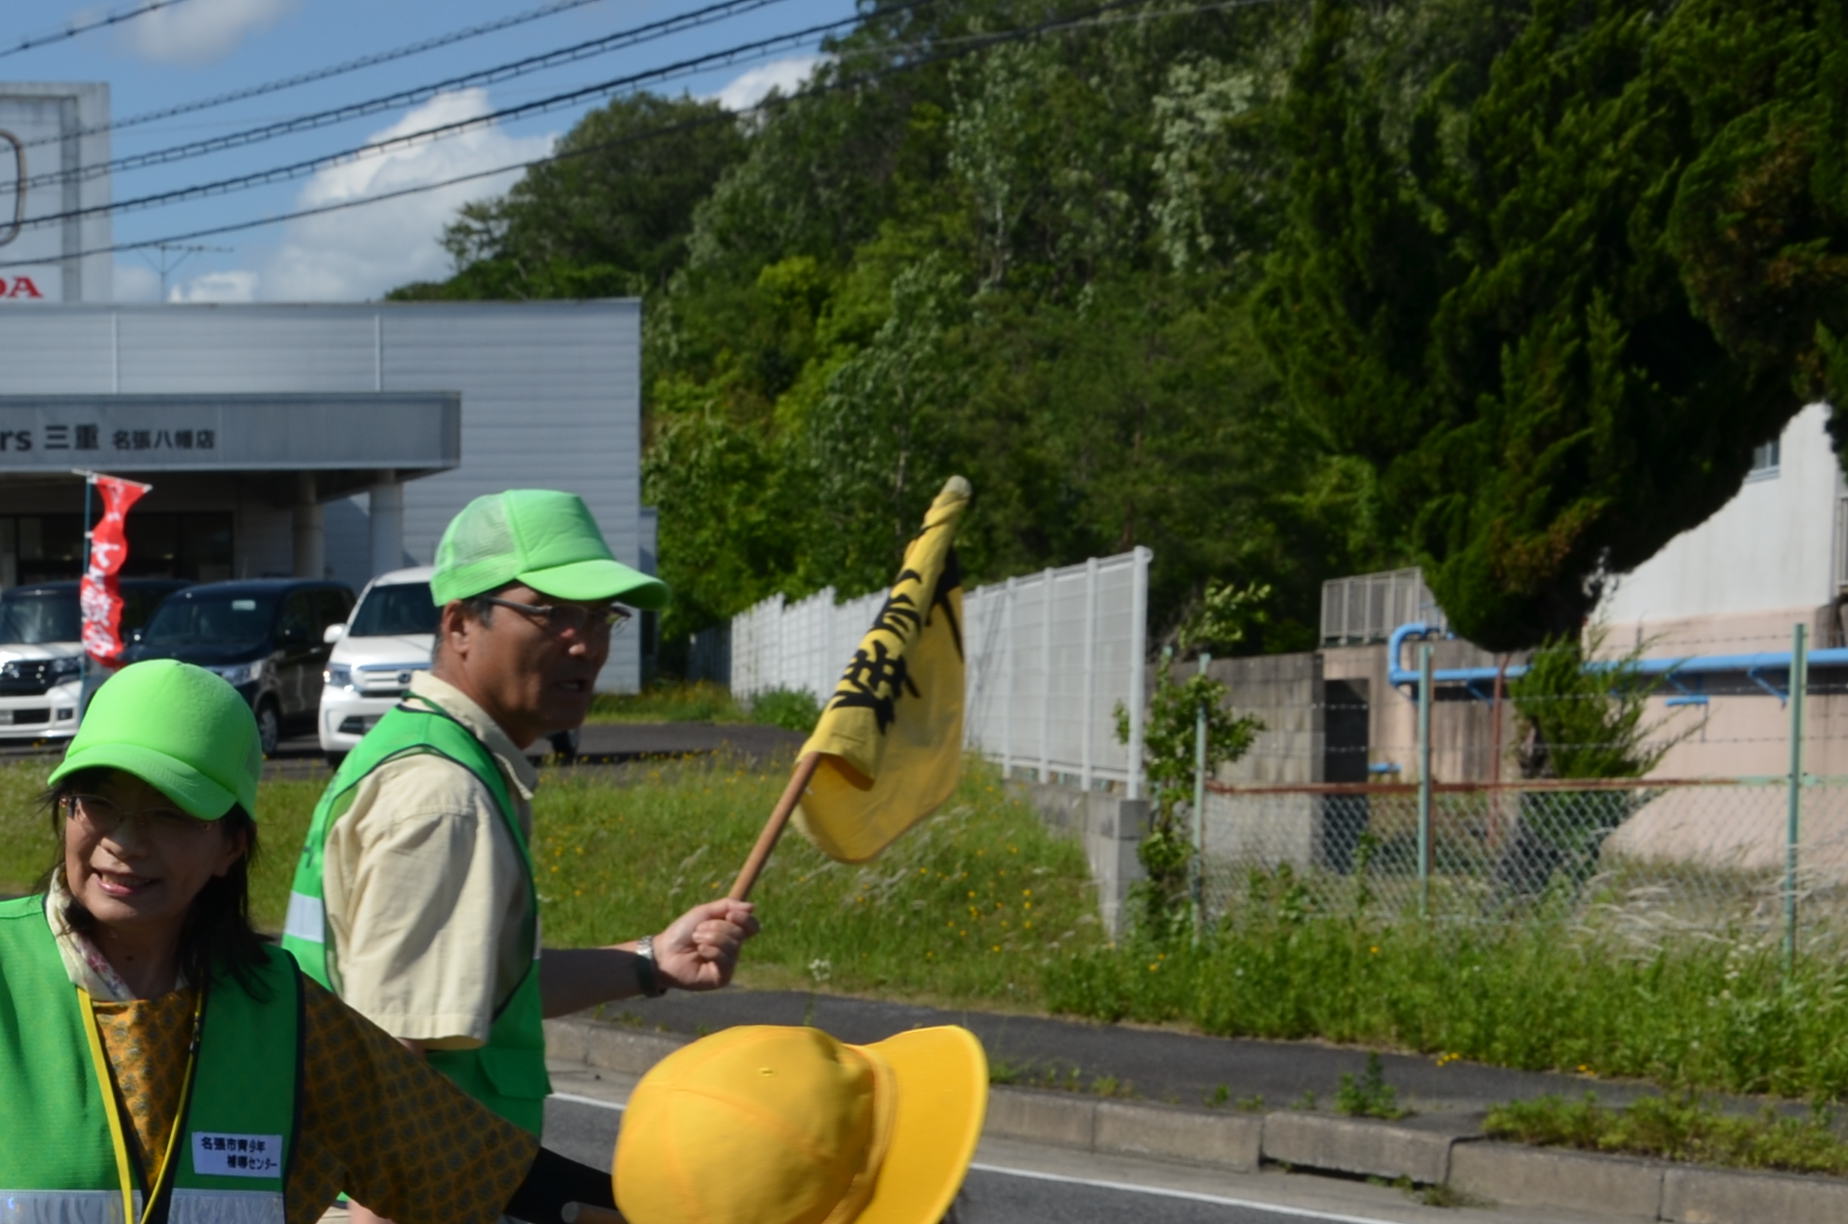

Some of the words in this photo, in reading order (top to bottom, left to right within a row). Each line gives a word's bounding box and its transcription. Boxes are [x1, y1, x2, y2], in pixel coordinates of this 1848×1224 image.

[43, 423, 100, 451] 三重
[200, 1136, 266, 1153] 名張市青少年
[226, 1153, 279, 1171] 補導センター
